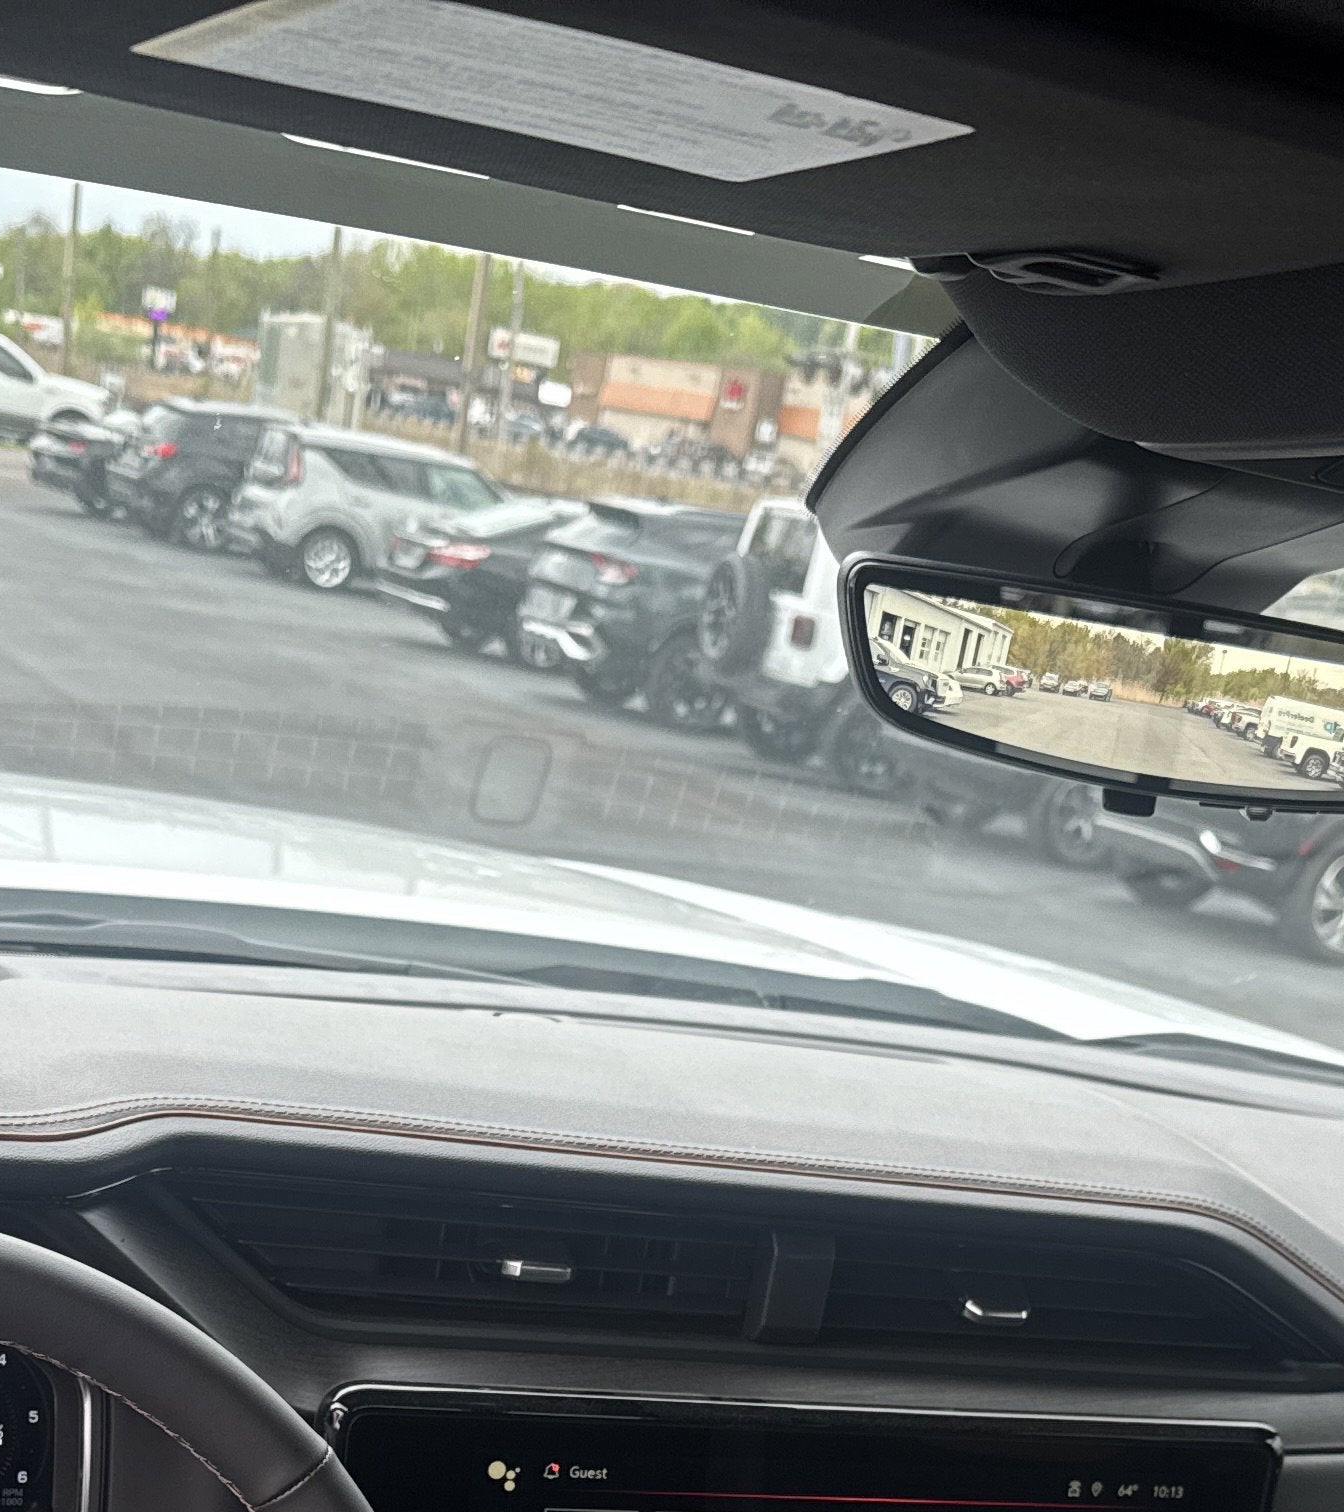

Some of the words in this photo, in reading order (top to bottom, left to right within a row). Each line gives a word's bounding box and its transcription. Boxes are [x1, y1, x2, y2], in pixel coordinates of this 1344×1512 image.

[28, 1410, 39, 1424] 5
[17, 1470, 28, 1484] 6
[569, 1465, 608, 1480] Guest
[1152, 1485, 1185, 1499] 10:13
